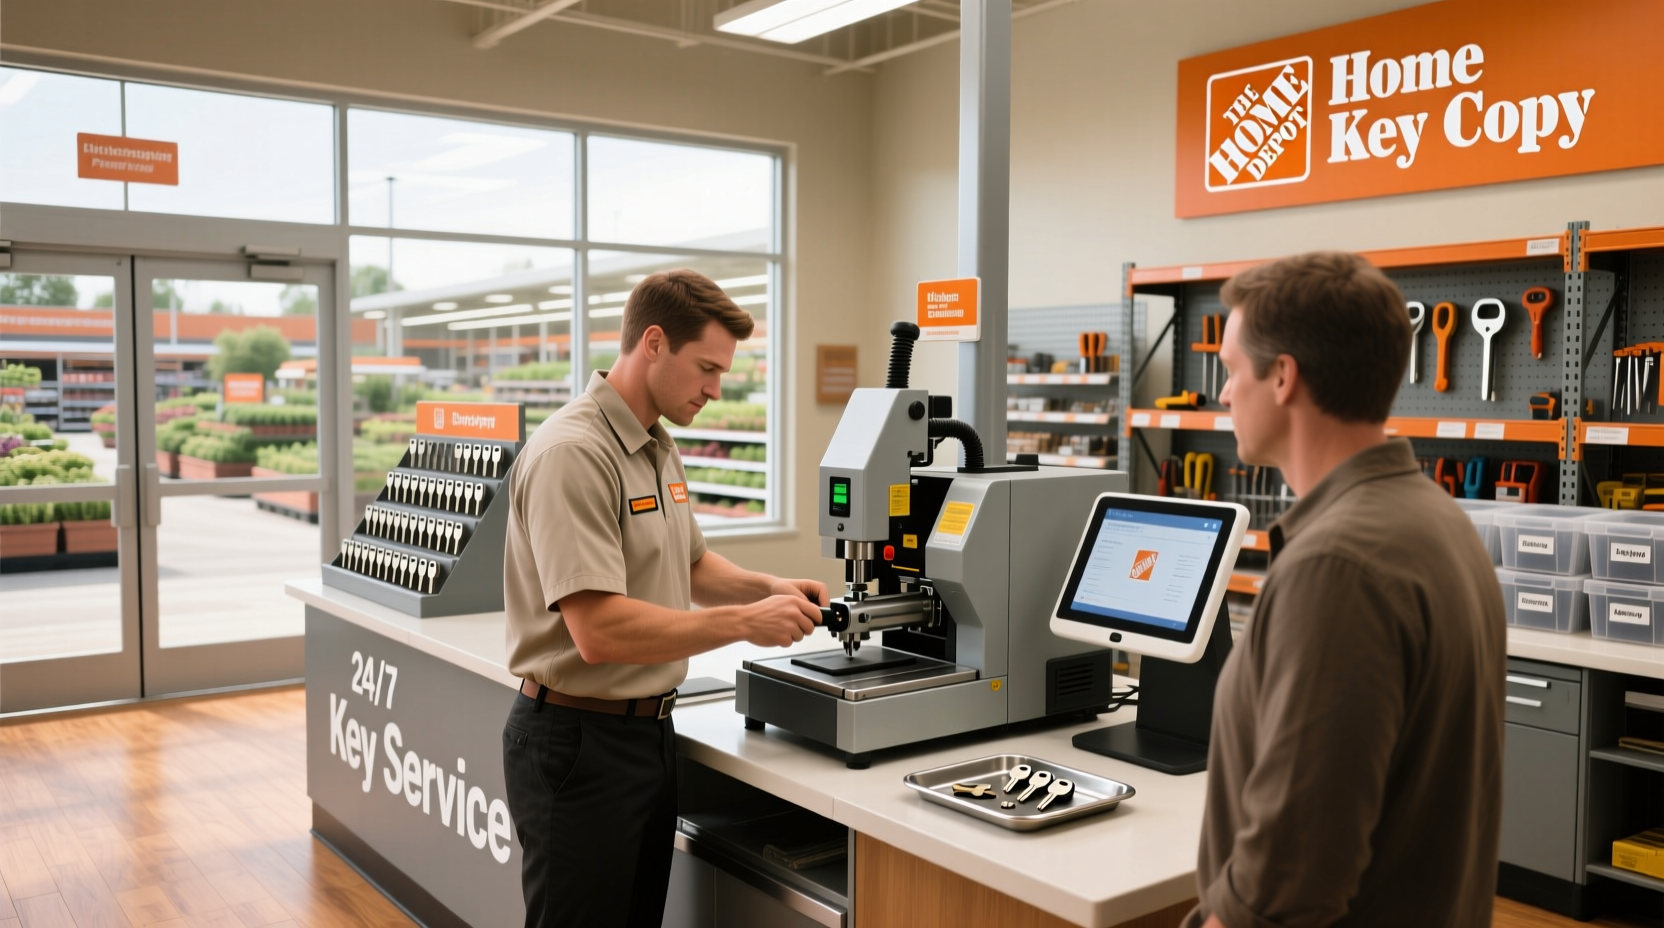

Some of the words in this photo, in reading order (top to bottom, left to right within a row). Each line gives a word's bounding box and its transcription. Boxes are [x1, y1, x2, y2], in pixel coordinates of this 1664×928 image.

[1222, 83, 1259, 127] THE
[1328, 43, 1484, 106] Home
[1208, 64, 1309, 185] HOME
[1245, 106, 1308, 181] DEPOT
[1327, 109, 1429, 169] Key
[1443, 88, 1596, 154] Copy
[352, 651, 398, 710] 24/7
[330, 692, 377, 793] Key
[383, 722, 511, 864] Service
